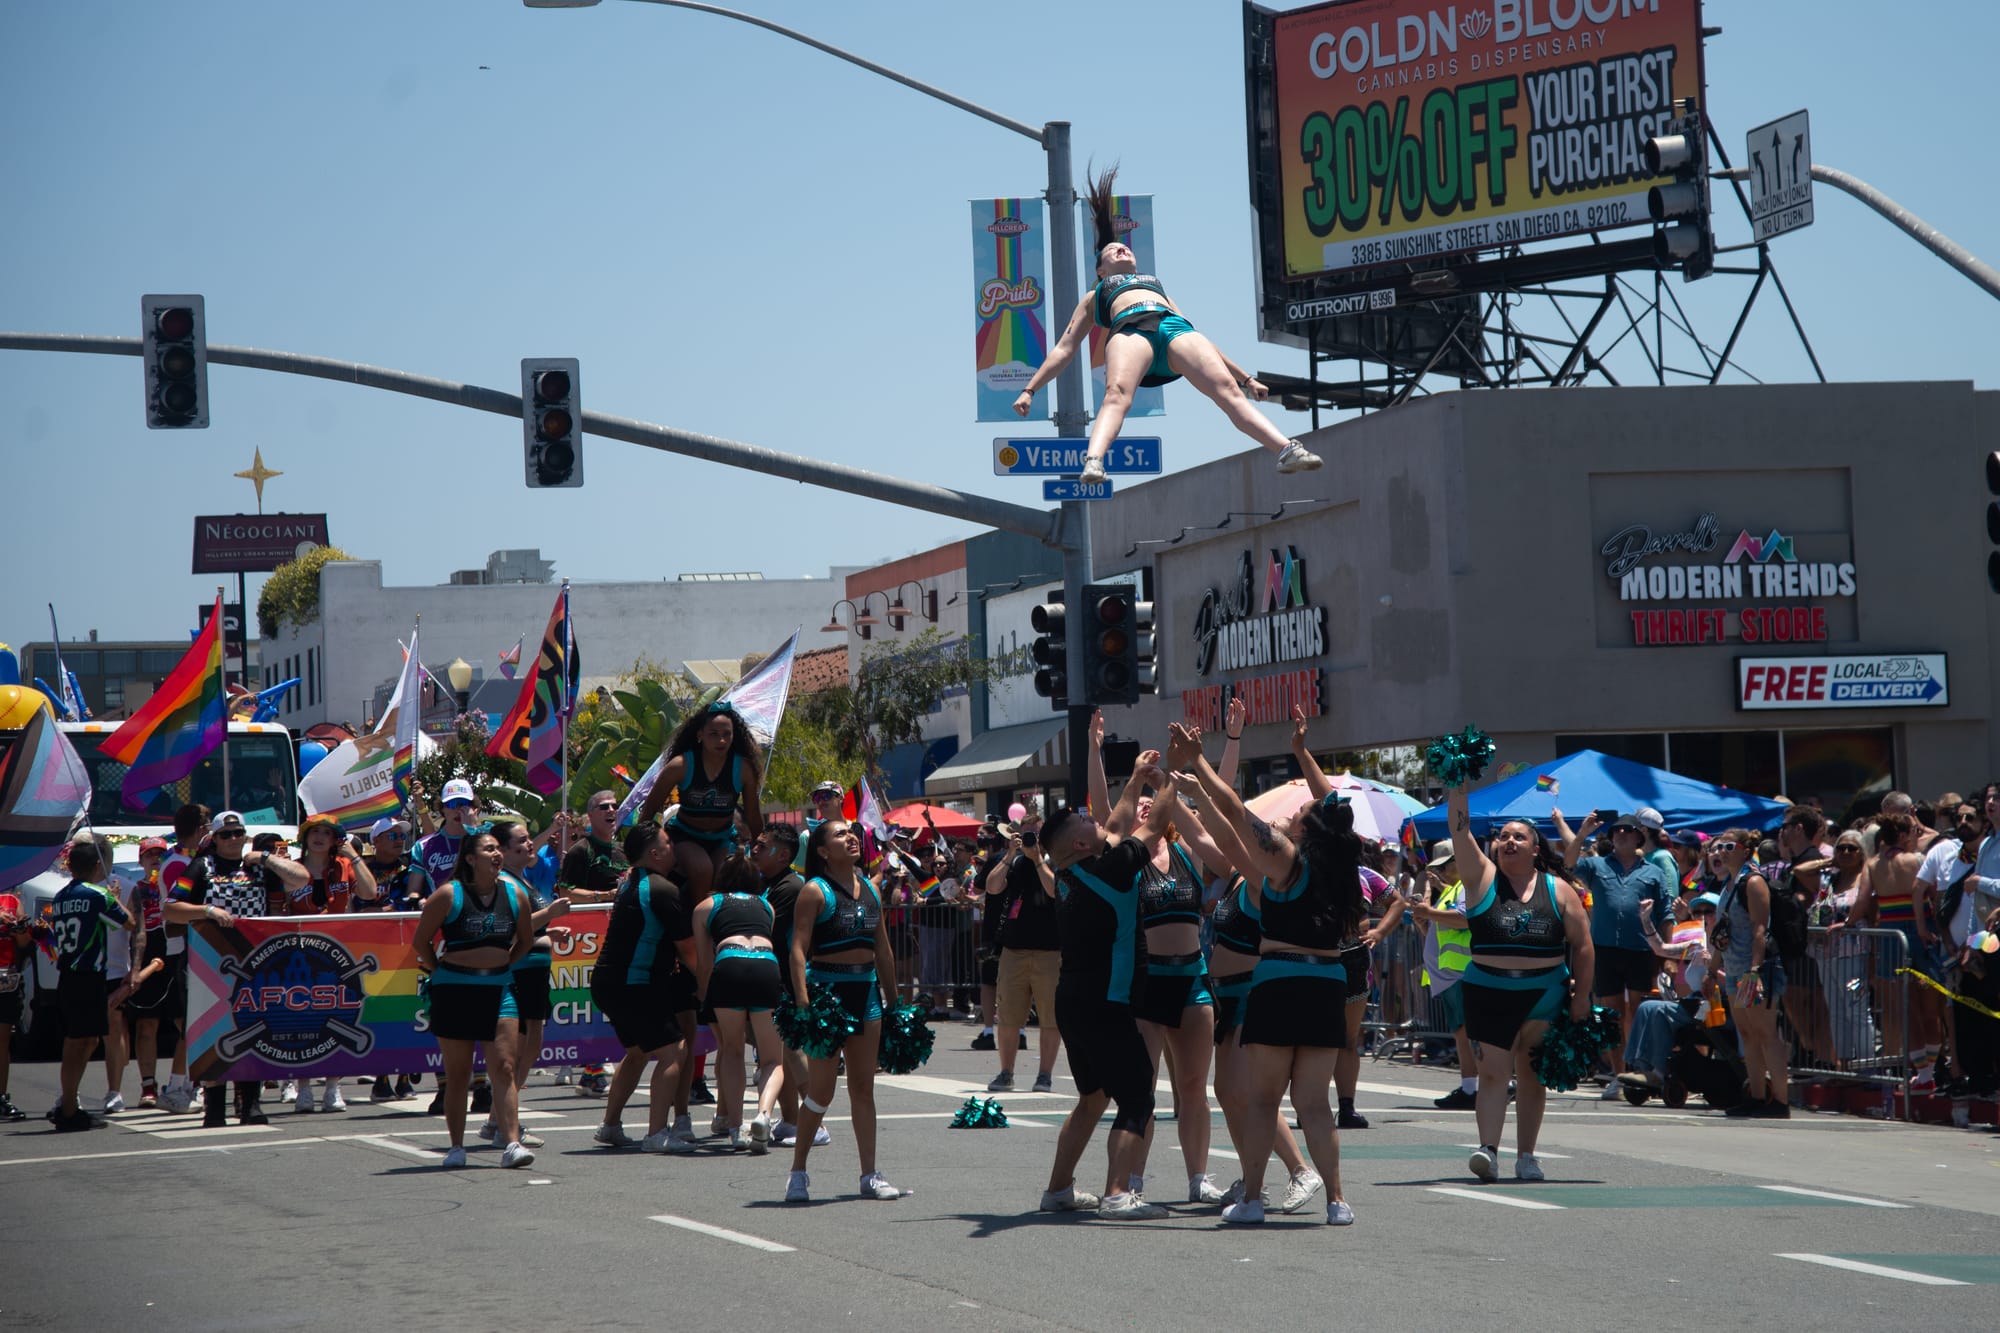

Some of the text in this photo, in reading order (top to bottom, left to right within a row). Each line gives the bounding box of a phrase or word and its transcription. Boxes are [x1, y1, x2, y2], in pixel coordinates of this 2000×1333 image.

[1309, 6, 1458, 79] GOLDN
[1357, 29, 1607, 93] CANNABIS DISPENSARY
[1527, 50, 1674, 130] YOUR FIRST
[1754, 183, 1809, 216] ONLY ONLY ONLY
[1352, 241, 1382, 265] 3385
[1385, 231, 1442, 261] SUNSHINE
[1497, 219, 1521, 242] SAN
[1525, 212, 1560, 238] DIEGO
[1762, 219, 1772, 236] NO
[1783, 208, 1804, 227] TURN
[980, 280, 1035, 313] Pride
[1026, 446, 1114, 468] VERMT
[1072, 483, 1105, 497] 3900
[1620, 562, 1857, 600] MODERN TRENDS
[1218, 606, 1324, 672] MODERN TRENDS
[1631, 606, 1827, 646] THRIFT STORE
[1743, 662, 1884, 702] FREE LOCAL
[1836, 682, 1928, 699] DELIVERY
[63, 898, 91, 914] DIEGO
[250, 936, 350, 969] AMERICA'S FINEST CITY
[231, 984, 363, 1013] AFCSL
[255, 1036, 337, 1061] SOFTBALL LEAGUE
